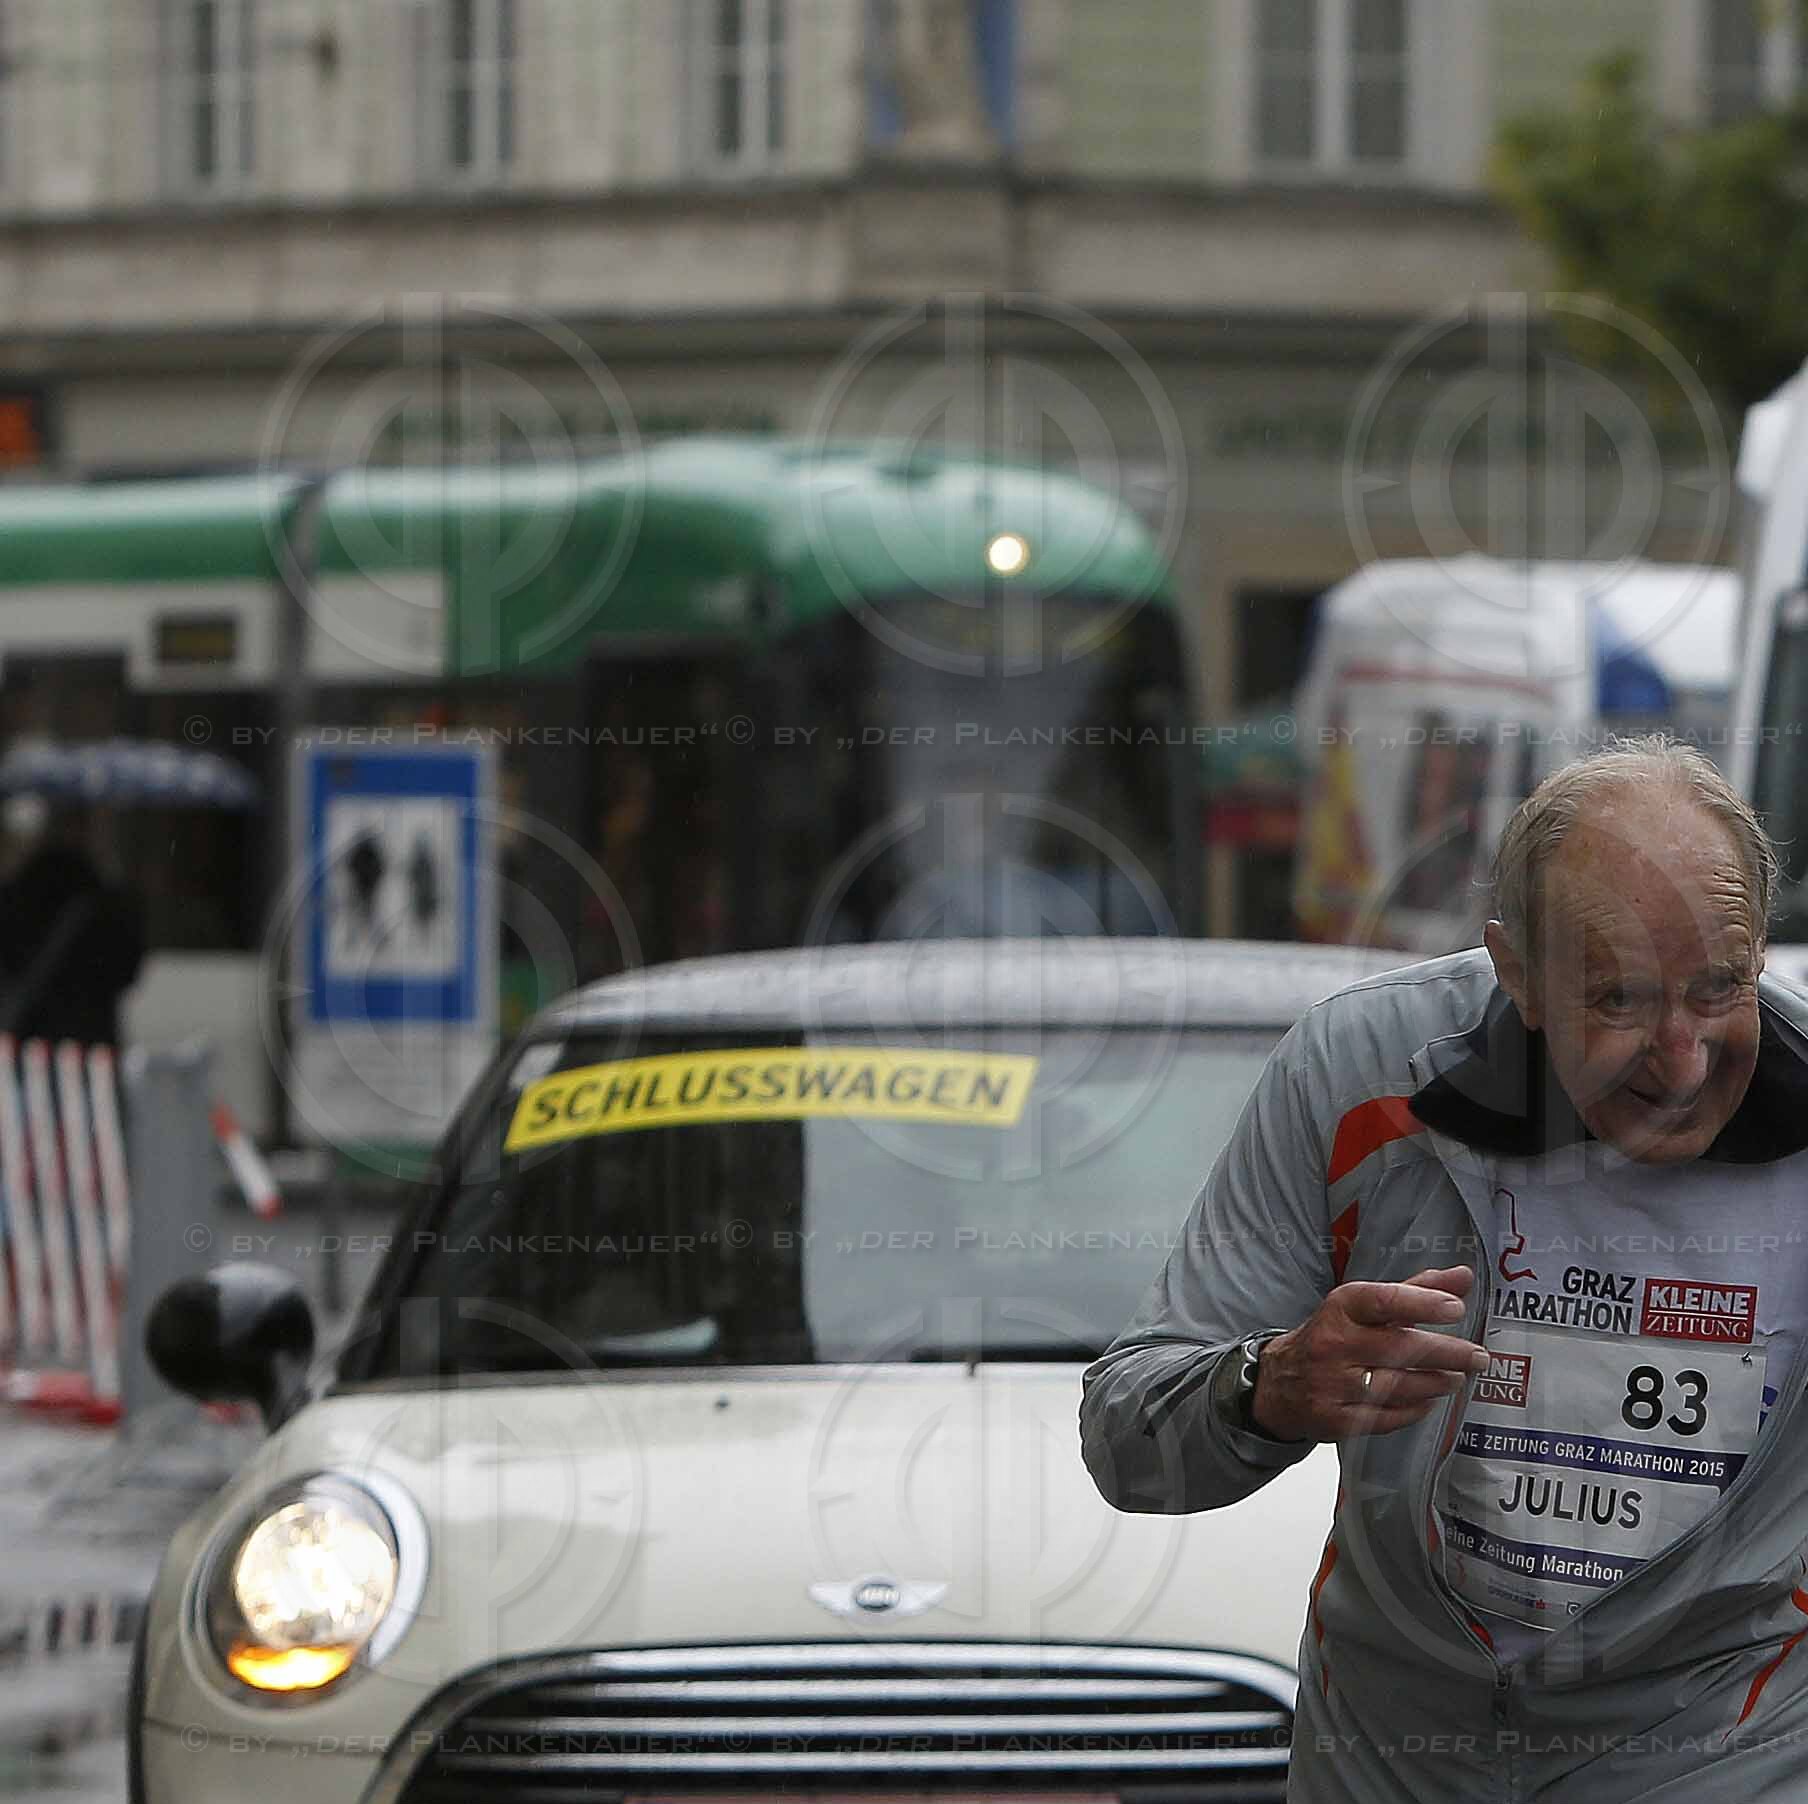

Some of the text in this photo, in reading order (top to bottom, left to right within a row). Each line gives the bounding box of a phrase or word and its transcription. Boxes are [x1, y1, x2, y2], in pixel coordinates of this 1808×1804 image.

[528, 1064, 1011, 1130] SCHLUSSWAGEN
[1563, 1266, 1636, 1302] GRAZ
[1650, 1286, 1750, 1314] KLEINE
[1647, 1314, 1748, 1337] ZEITUNG
[1621, 1365, 1708, 1436] 83
[1483, 1436, 1549, 1455] ZEITUNG
[1555, 1443, 1594, 1462] GRAZ
[1601, 1448, 1683, 1473] MARATHON
[1689, 1460, 1725, 1477] 2015
[1498, 1474, 1643, 1529] JULIUS
[1446, 1524, 1623, 1583] eine Zeitung Marathon
